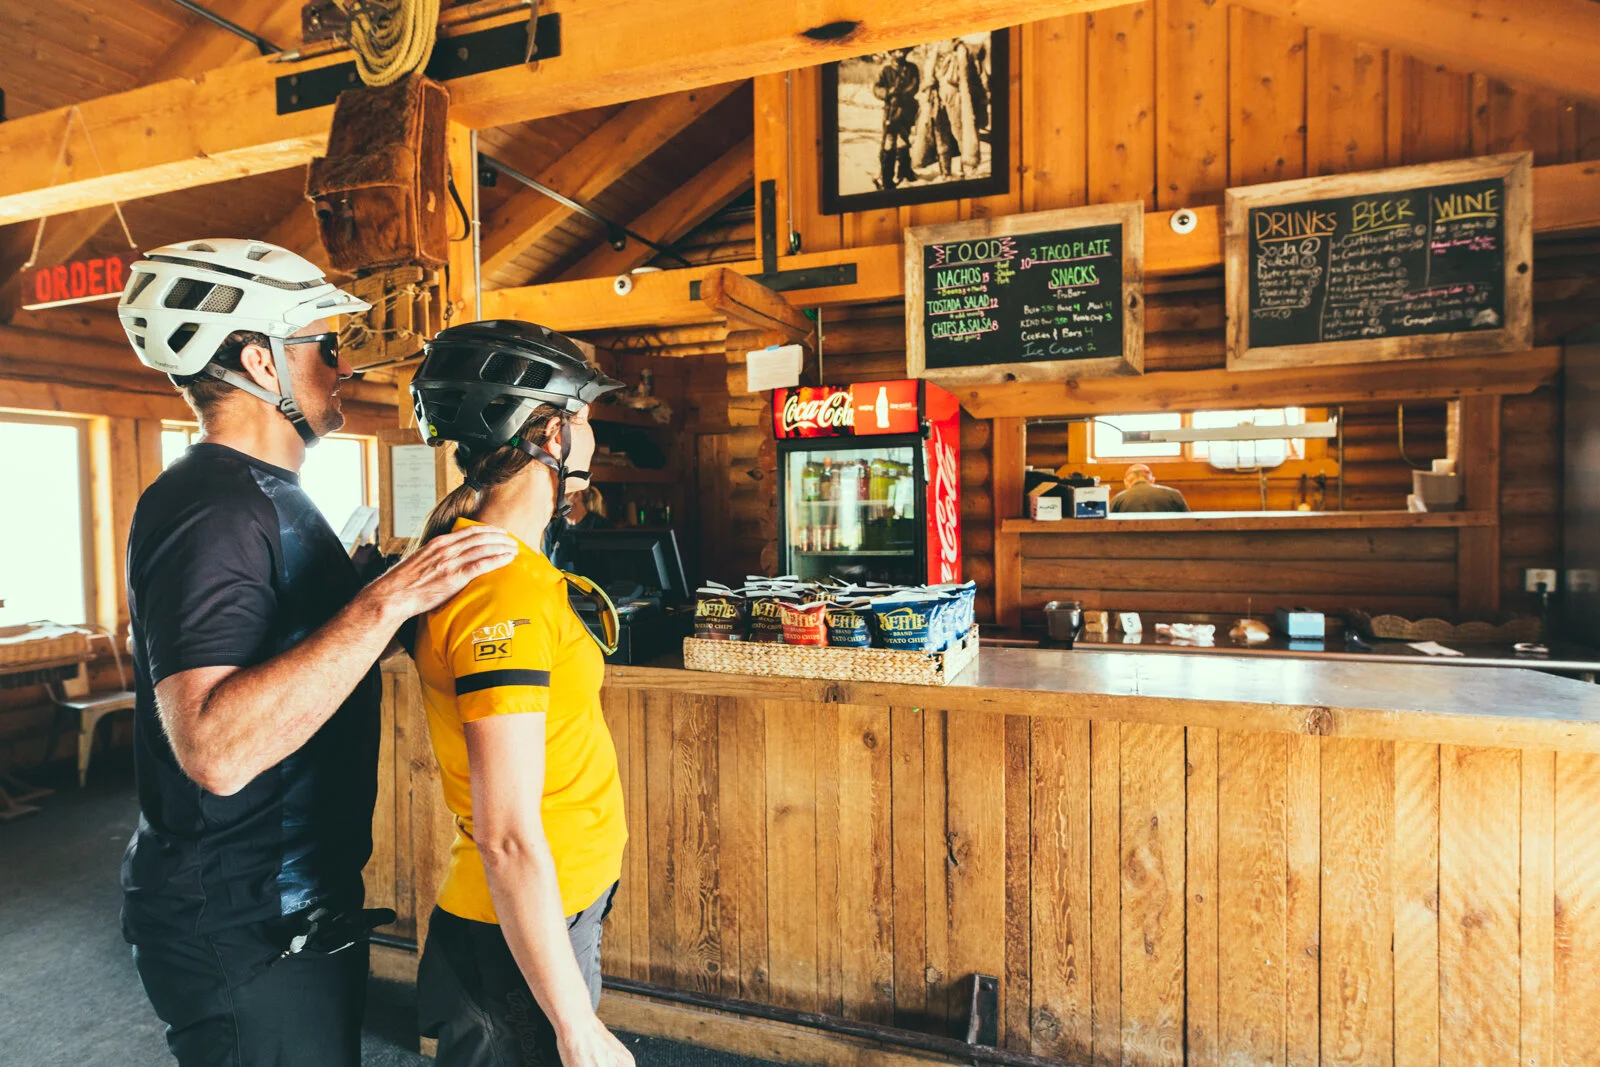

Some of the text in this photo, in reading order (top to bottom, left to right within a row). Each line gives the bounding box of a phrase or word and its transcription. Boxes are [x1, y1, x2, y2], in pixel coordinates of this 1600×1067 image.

[1434, 189, 1500, 217] WINE
[1255, 210, 1337, 239] DRINKS
[1352, 199, 1416, 232] BEER
[945, 240, 1002, 263] FOOD
[1030, 239, 1111, 261] 3 TACO PLATE
[1257, 241, 1298, 258] Soda
[1020, 257, 1032, 270] 10
[35, 256, 124, 302] ORDER
[937, 267, 982, 288] NACHOS
[1051, 265, 1097, 287] SNACKS
[926, 294, 999, 314] TOSTADA SALAD 12
[1073, 303, 1080, 311] 4
[931, 317, 999, 337] CHIPS & SALSA 8
[1021, 330, 1051, 341] Cookies
[1061, 327, 1083, 338] Bars
[1084, 326, 1094, 337] 4
[1021, 342, 1097, 357] Ice Cream 2
[782, 391, 854, 431] Coca-Cola
[694, 598, 737, 619] KETTLE
[751, 598, 782, 617] KETT
[780, 605, 820, 628] KETTLE
[825, 611, 866, 629] KETTLE
[877, 607, 929, 631] KETTLE
[478, 642, 509, 657] DK
